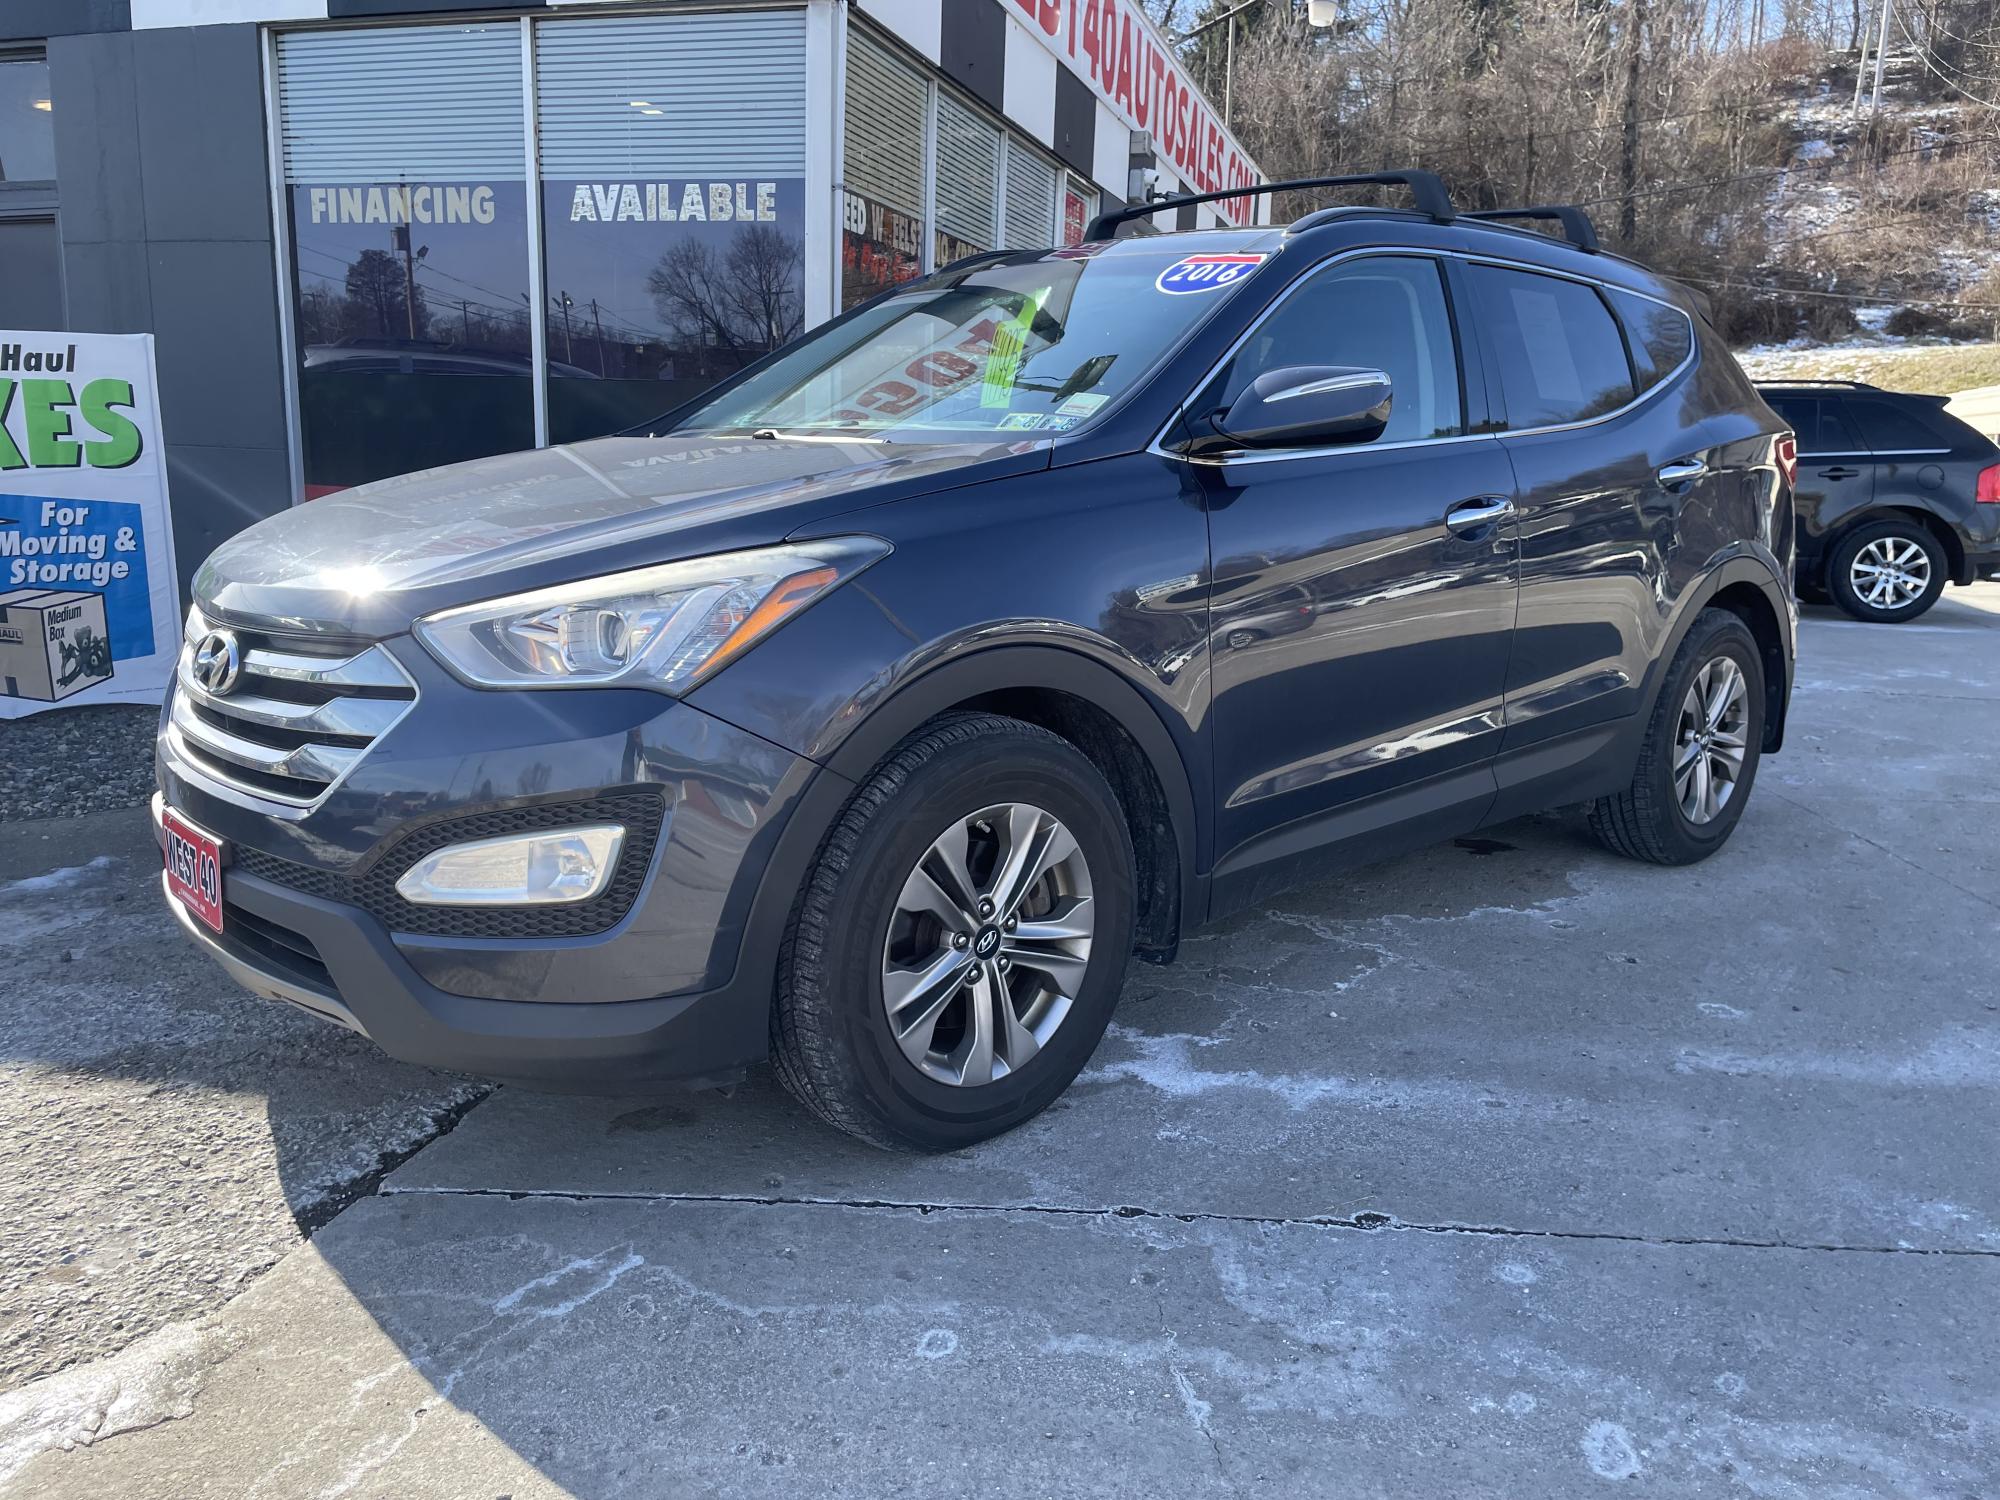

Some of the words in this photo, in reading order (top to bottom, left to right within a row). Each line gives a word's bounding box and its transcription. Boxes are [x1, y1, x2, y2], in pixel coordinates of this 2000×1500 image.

[1014, 0, 1254, 227] 40AUTOSALES.COM
[311, 185, 496, 224] FINANCING
[570, 183, 777, 222] AVAILABLE
[871, 203, 923, 258] WEELS?
[1166, 264, 1247, 282] 2016
[0, 344, 76, 372] Haul
[41, 501, 89, 527] For
[0, 527, 106, 560] Moving
[114, 526, 137, 552] &
[10, 558, 129, 587] Storage
[48, 605, 82, 627] Medium
[0, 629, 22, 639] AUL
[49, 626, 65, 641] Box
[163, 825, 199, 894] WEST
[200, 850, 218, 908] 40
